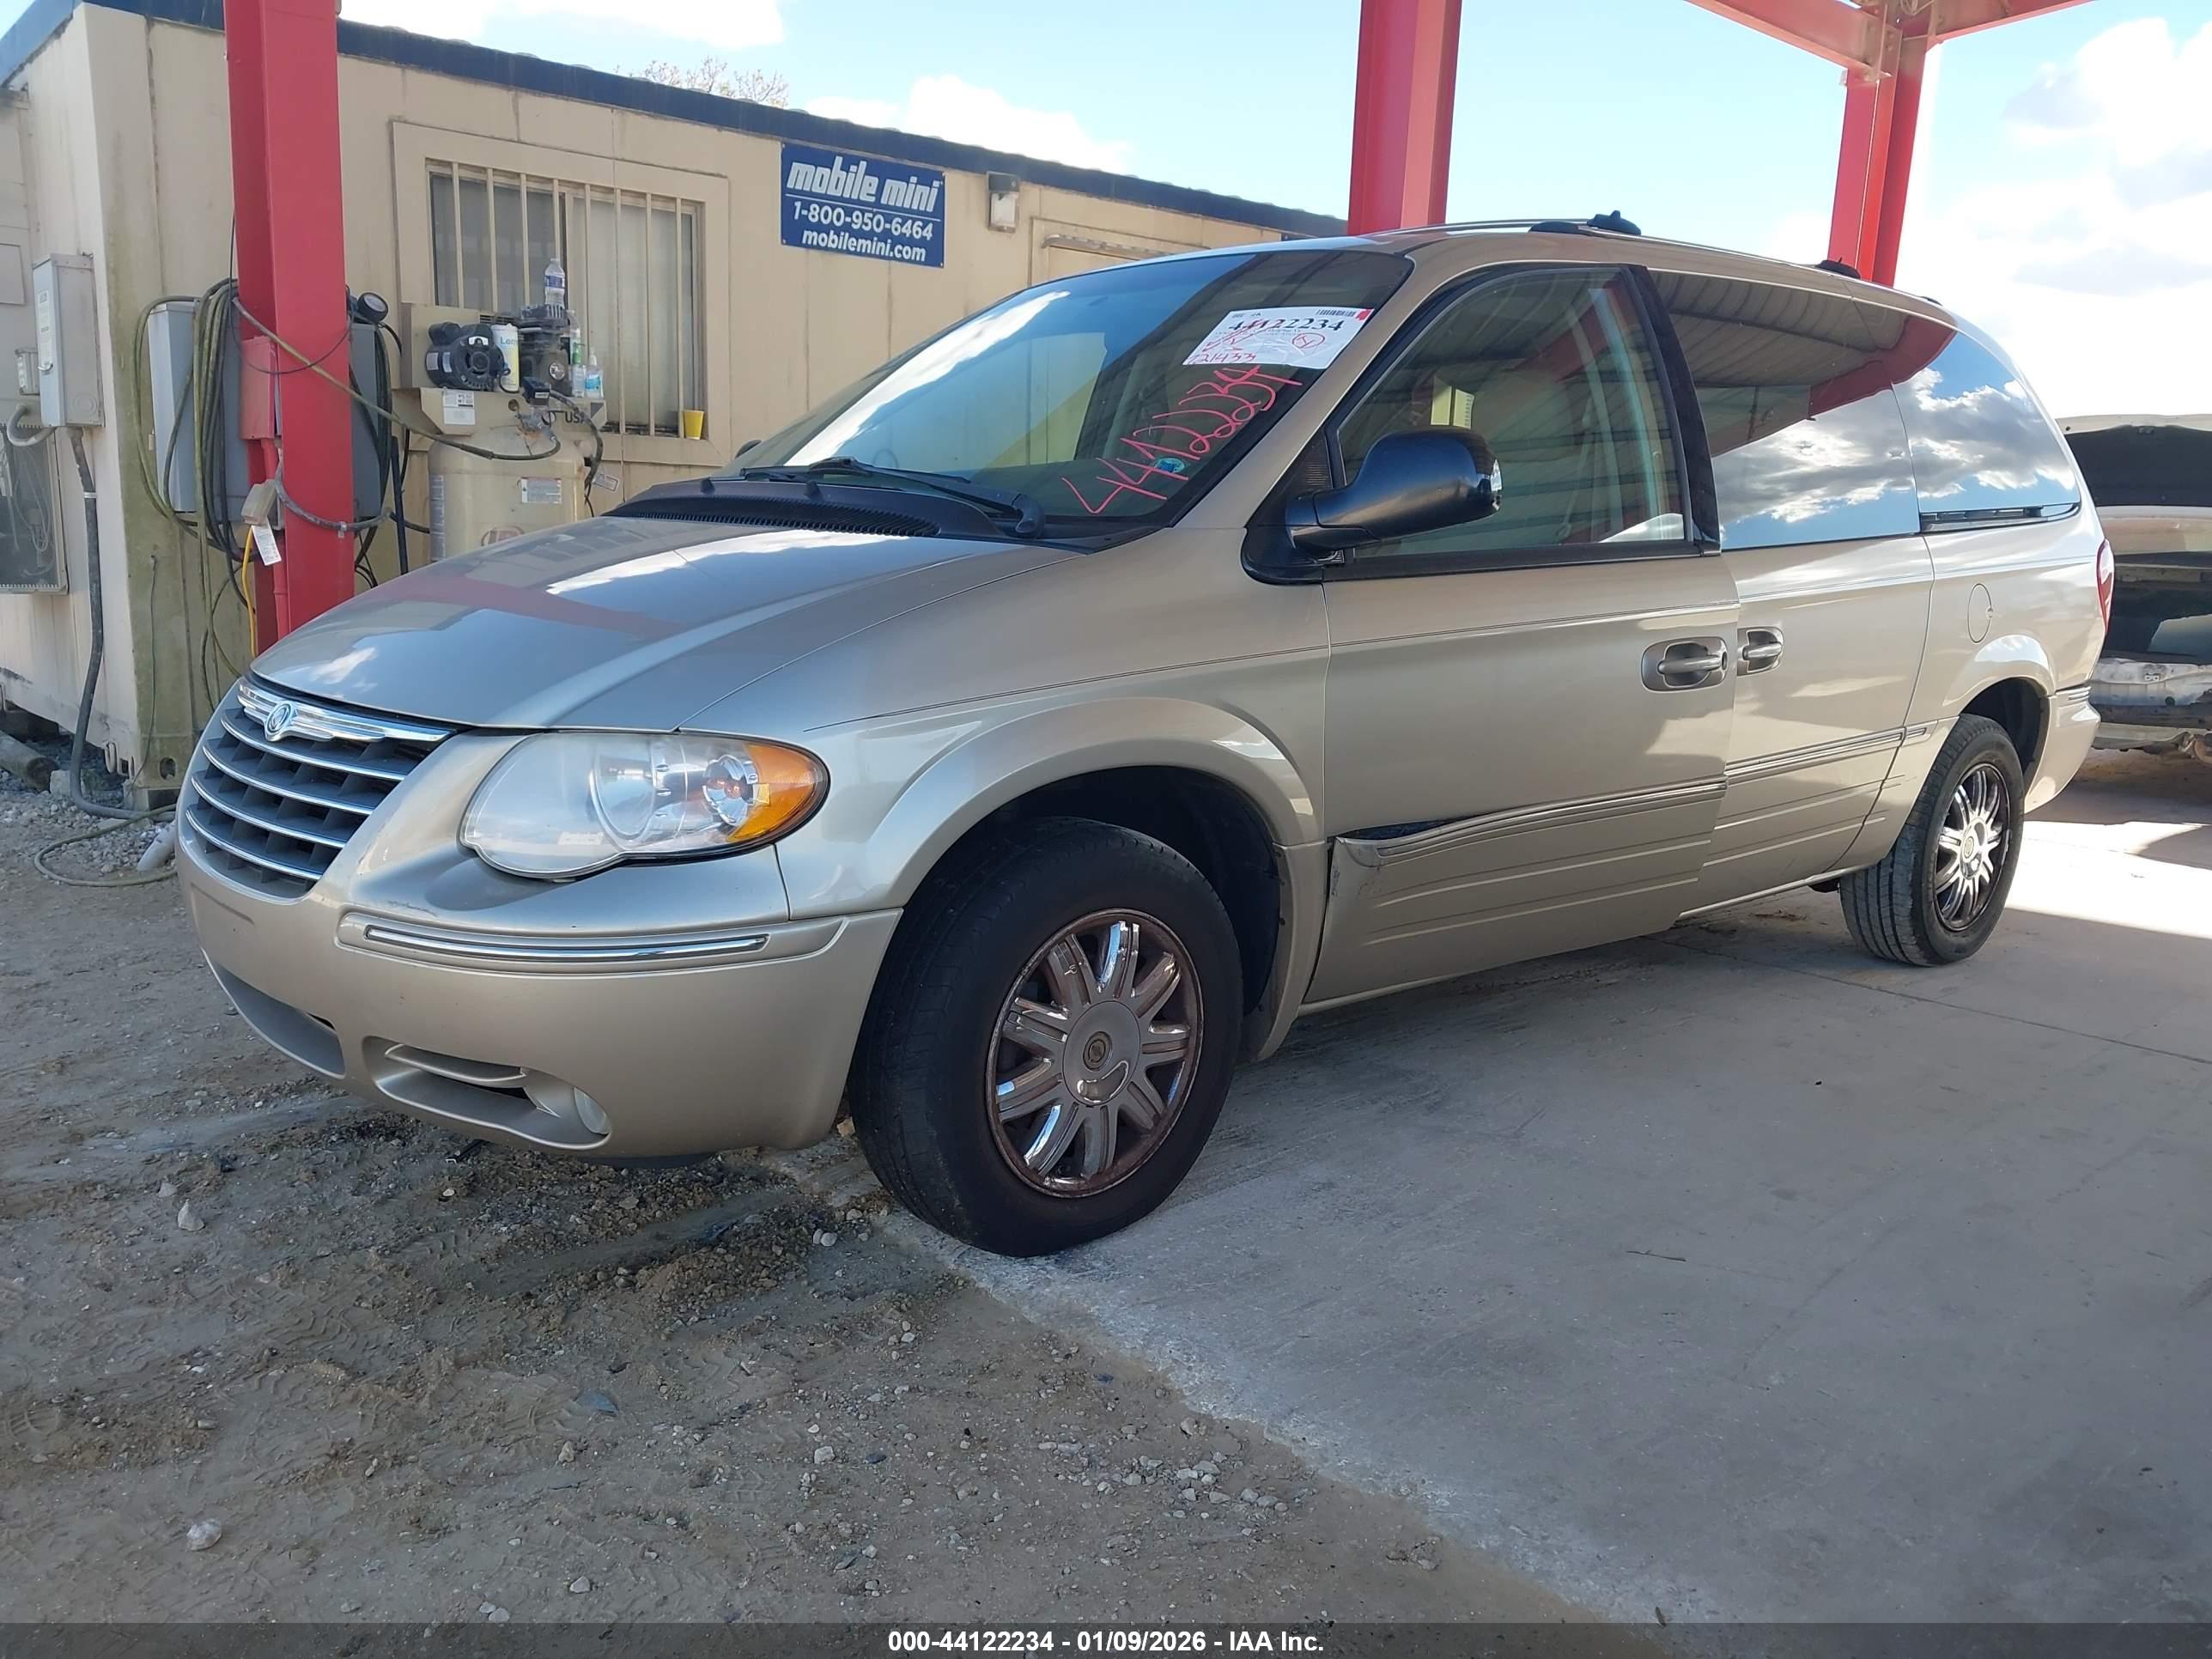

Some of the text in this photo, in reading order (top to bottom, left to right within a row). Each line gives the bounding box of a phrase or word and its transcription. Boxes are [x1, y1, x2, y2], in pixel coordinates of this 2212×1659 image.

[787, 156, 939, 212] mobile mini
[793, 201, 933, 240] 1-800-950-6464
[801, 229, 927, 262] mobilemini.com
[1227, 319, 1346, 331] 44122234
